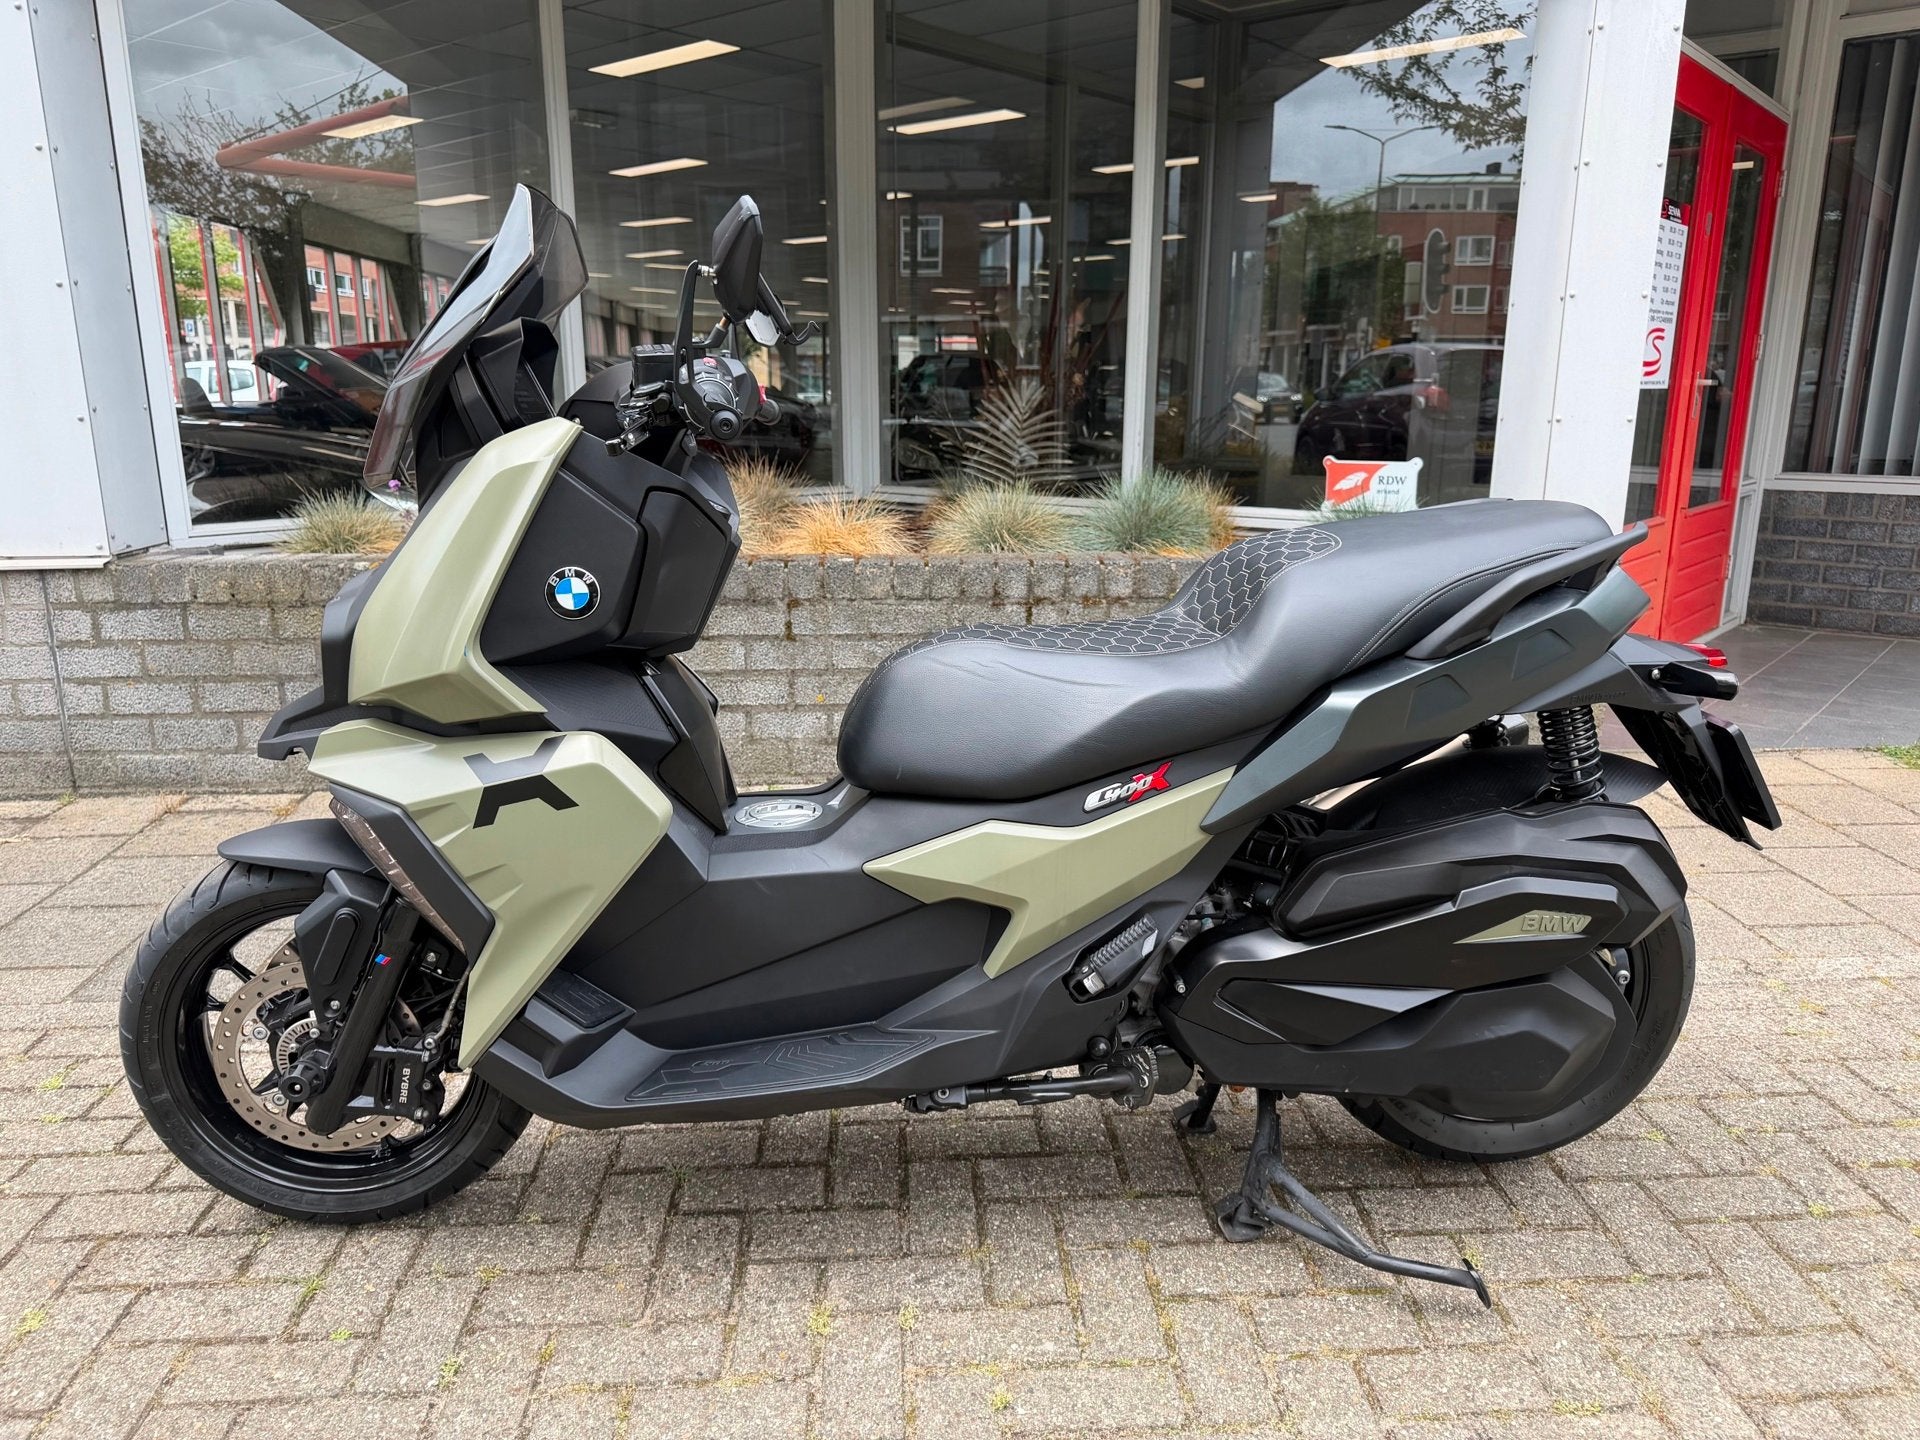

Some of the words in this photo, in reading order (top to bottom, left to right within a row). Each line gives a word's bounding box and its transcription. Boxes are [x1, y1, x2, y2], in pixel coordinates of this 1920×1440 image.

[1378, 475, 1405, 485] RDW
[548, 567, 594, 587] BMW
[1520, 914, 1586, 933] BMW
[399, 1067, 411, 1104] BYBRE
